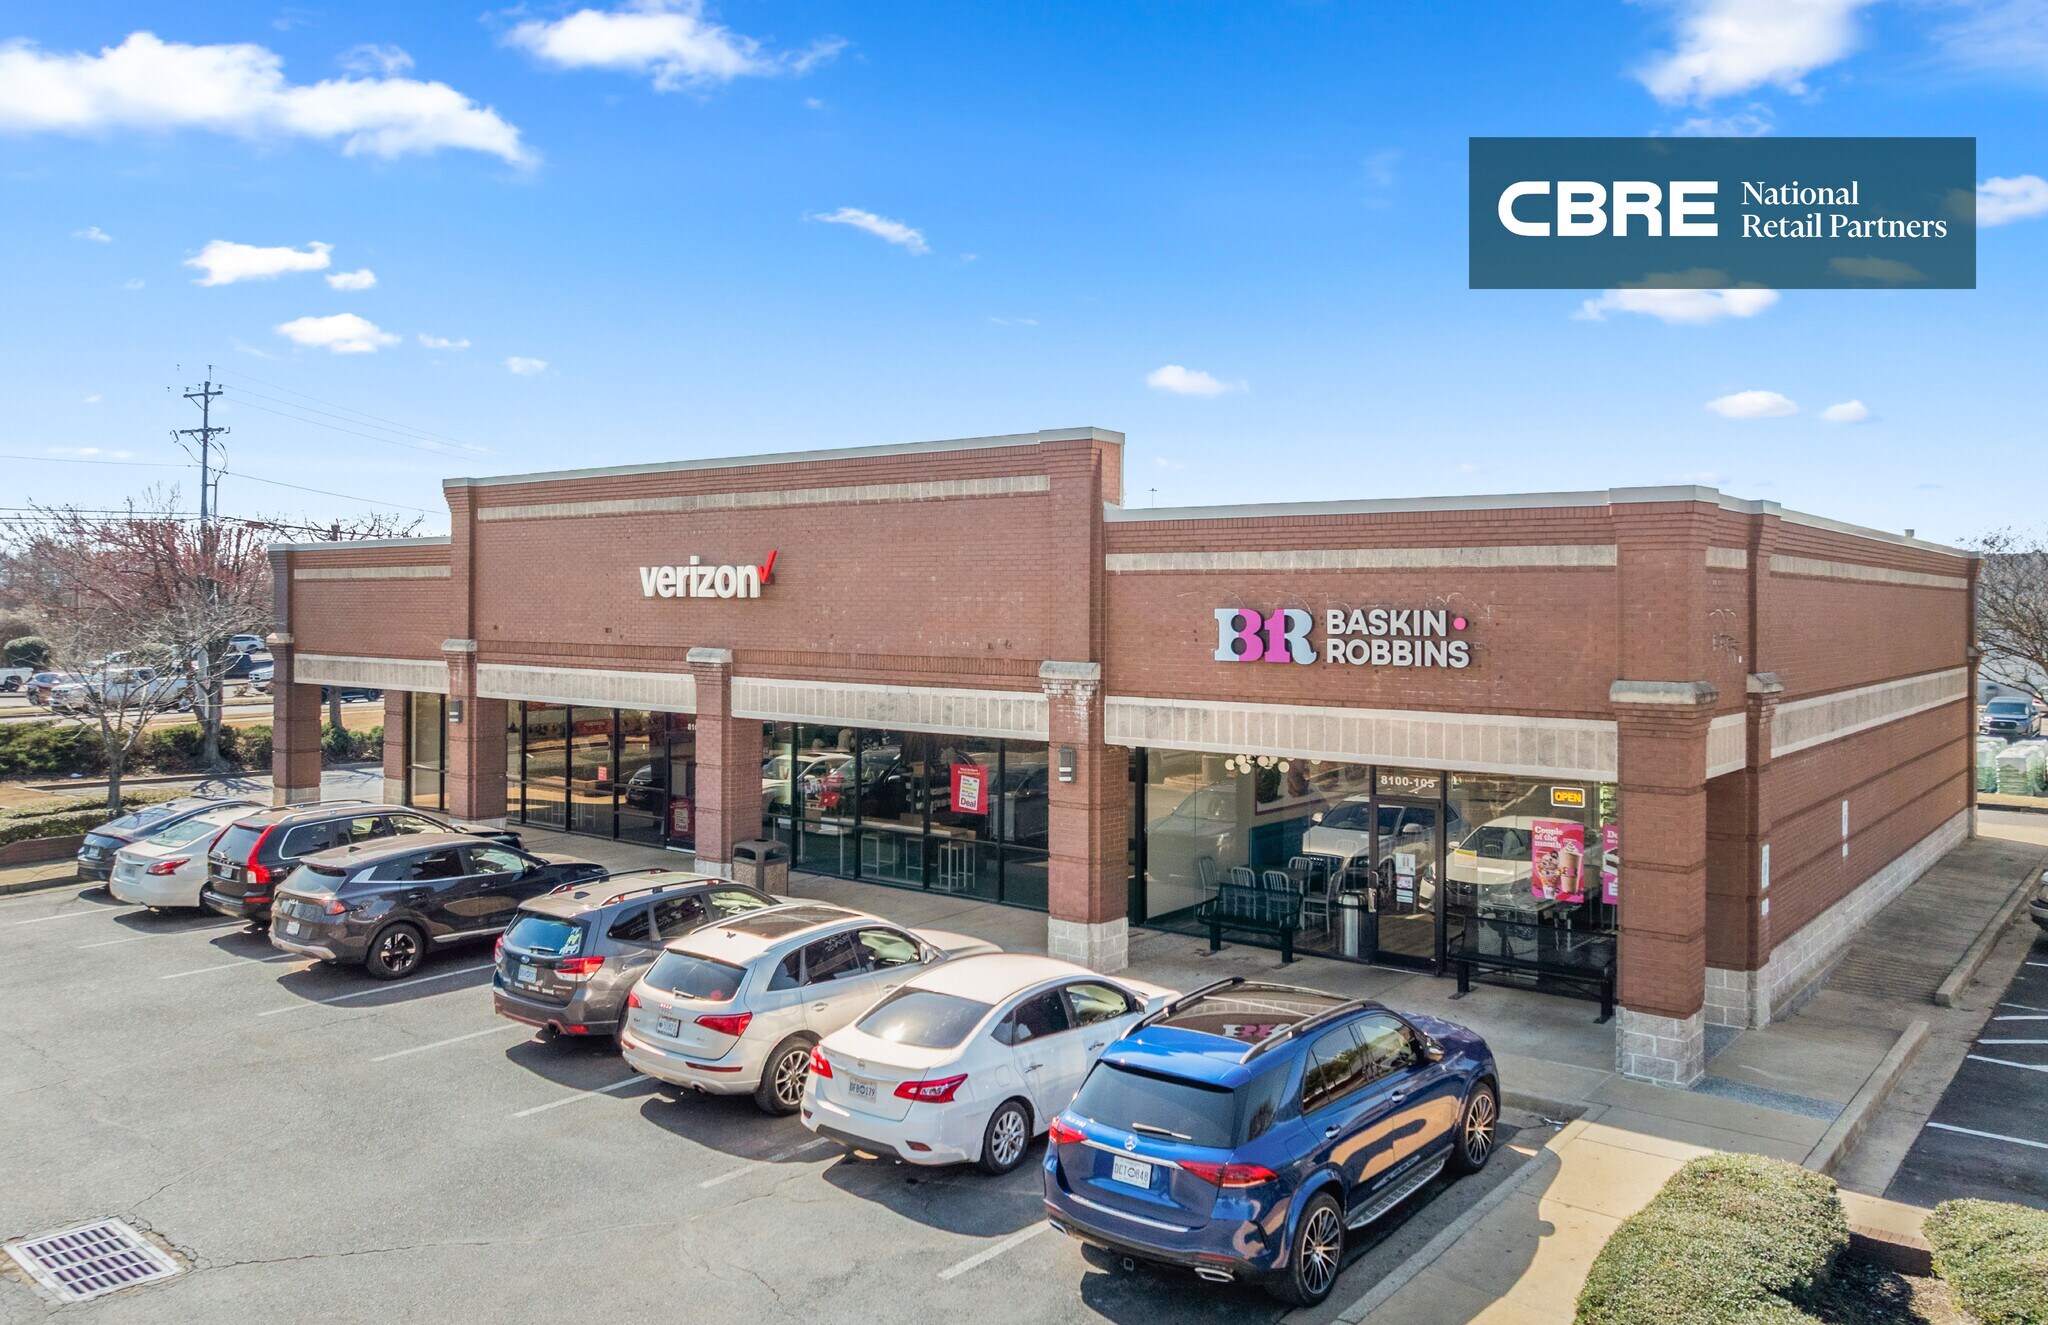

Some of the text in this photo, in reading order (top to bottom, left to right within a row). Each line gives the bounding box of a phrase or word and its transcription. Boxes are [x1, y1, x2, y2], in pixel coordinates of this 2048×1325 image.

[639, 555, 761, 599] verizon
[1326, 609, 1447, 637] BASKIN
[1326, 638, 1471, 668] ROBBINS
[1380, 775, 1435, 789] 8100-105
[960, 797, 977, 808] Deal
[1554, 791, 1582, 803] OPEN
[1534, 825, 1564, 836] Couple
[1543, 833, 1558, 841] the
[1534, 840, 1562, 849] month
